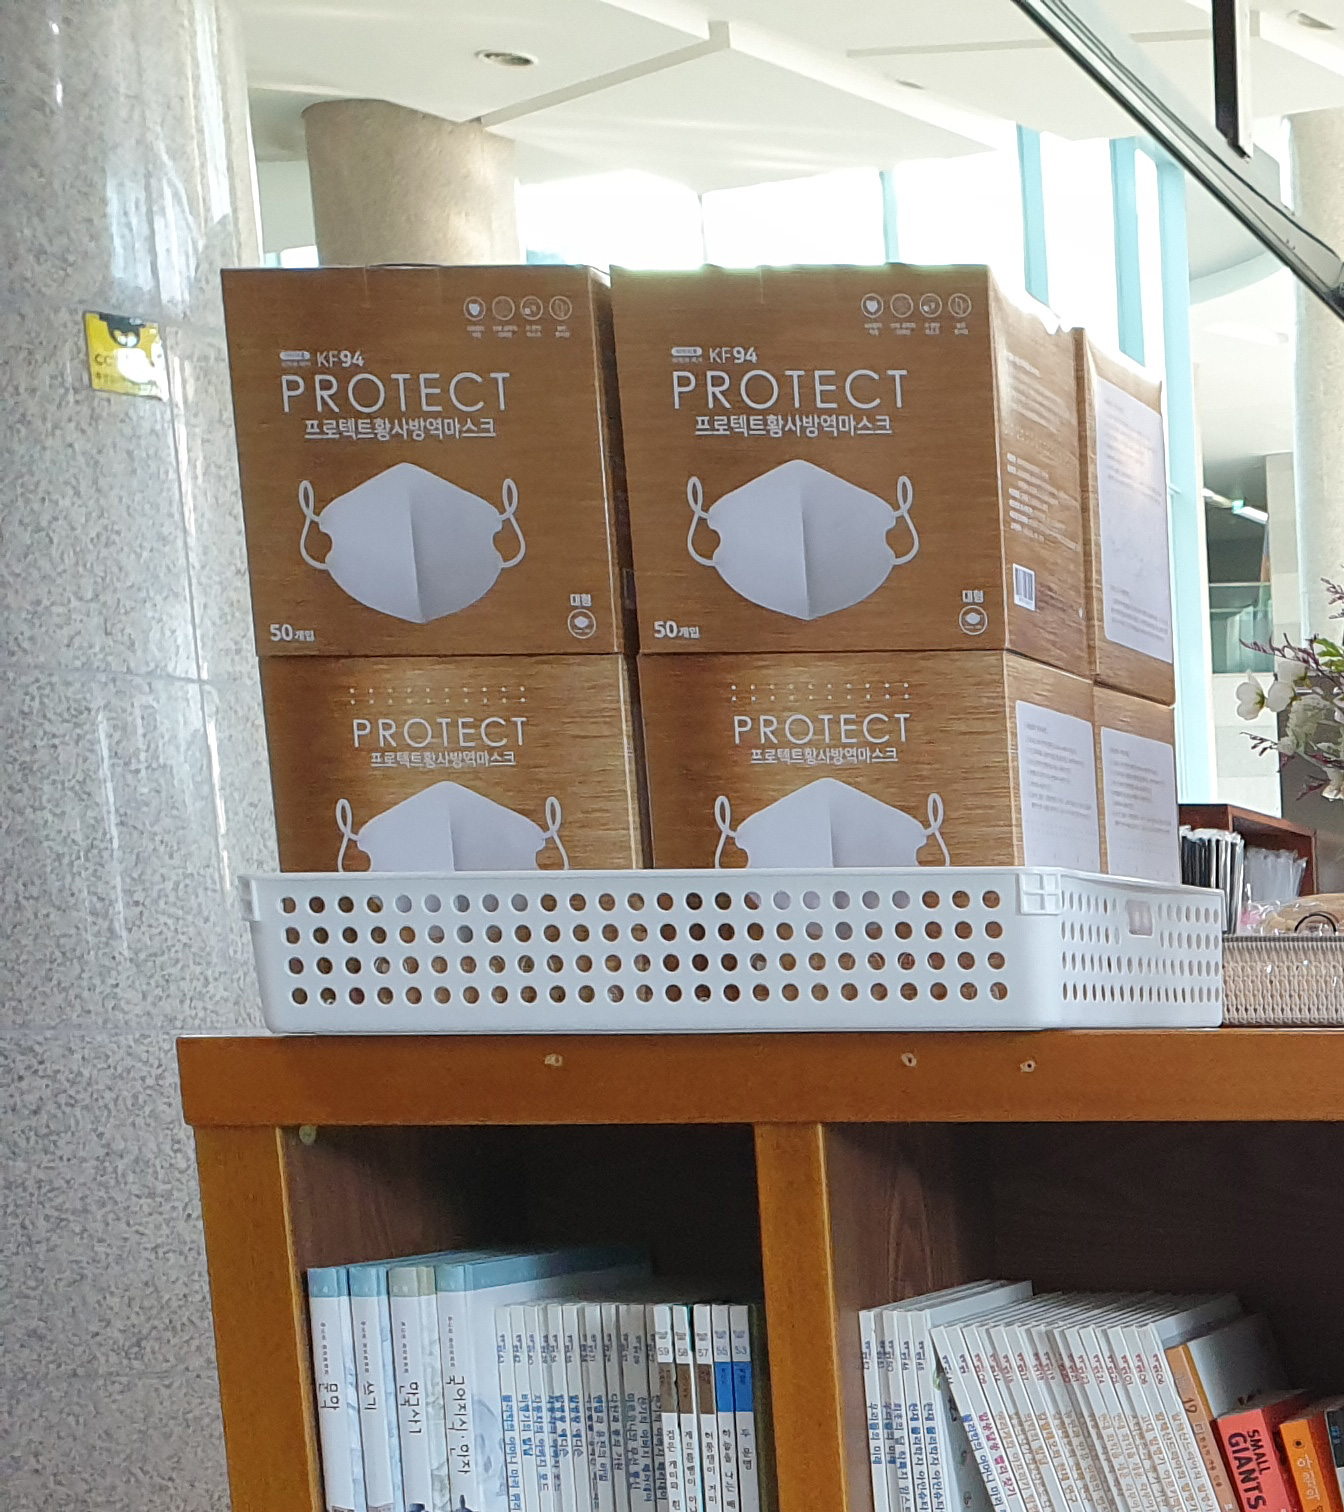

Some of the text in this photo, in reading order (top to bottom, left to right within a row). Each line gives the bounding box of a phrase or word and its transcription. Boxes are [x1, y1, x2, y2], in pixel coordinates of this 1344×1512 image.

[317, 350, 364, 368] KF94
[709, 347, 757, 363] KF94
[281, 373, 510, 412] PROTECT
[673, 369, 908, 409] PROTECT
[304, 418, 496, 440] 프로텍트황사방역마스크
[695, 415, 892, 436] 프로텍트황사방역마스크
[352, 717, 528, 748] PROTECT
[733, 712, 911, 745] PROTECT
[370, 750, 516, 768] 프로텍트황사방역마스크
[749, 747, 898, 765] 프로텍트황사방역마스크
[319, 1381, 340, 1411] 문학
[363, 1381, 376, 1411] 쓰기
[1247, 1429, 1270, 1475] SMALL
[1228, 1433, 1267, 1510] GIANTS
